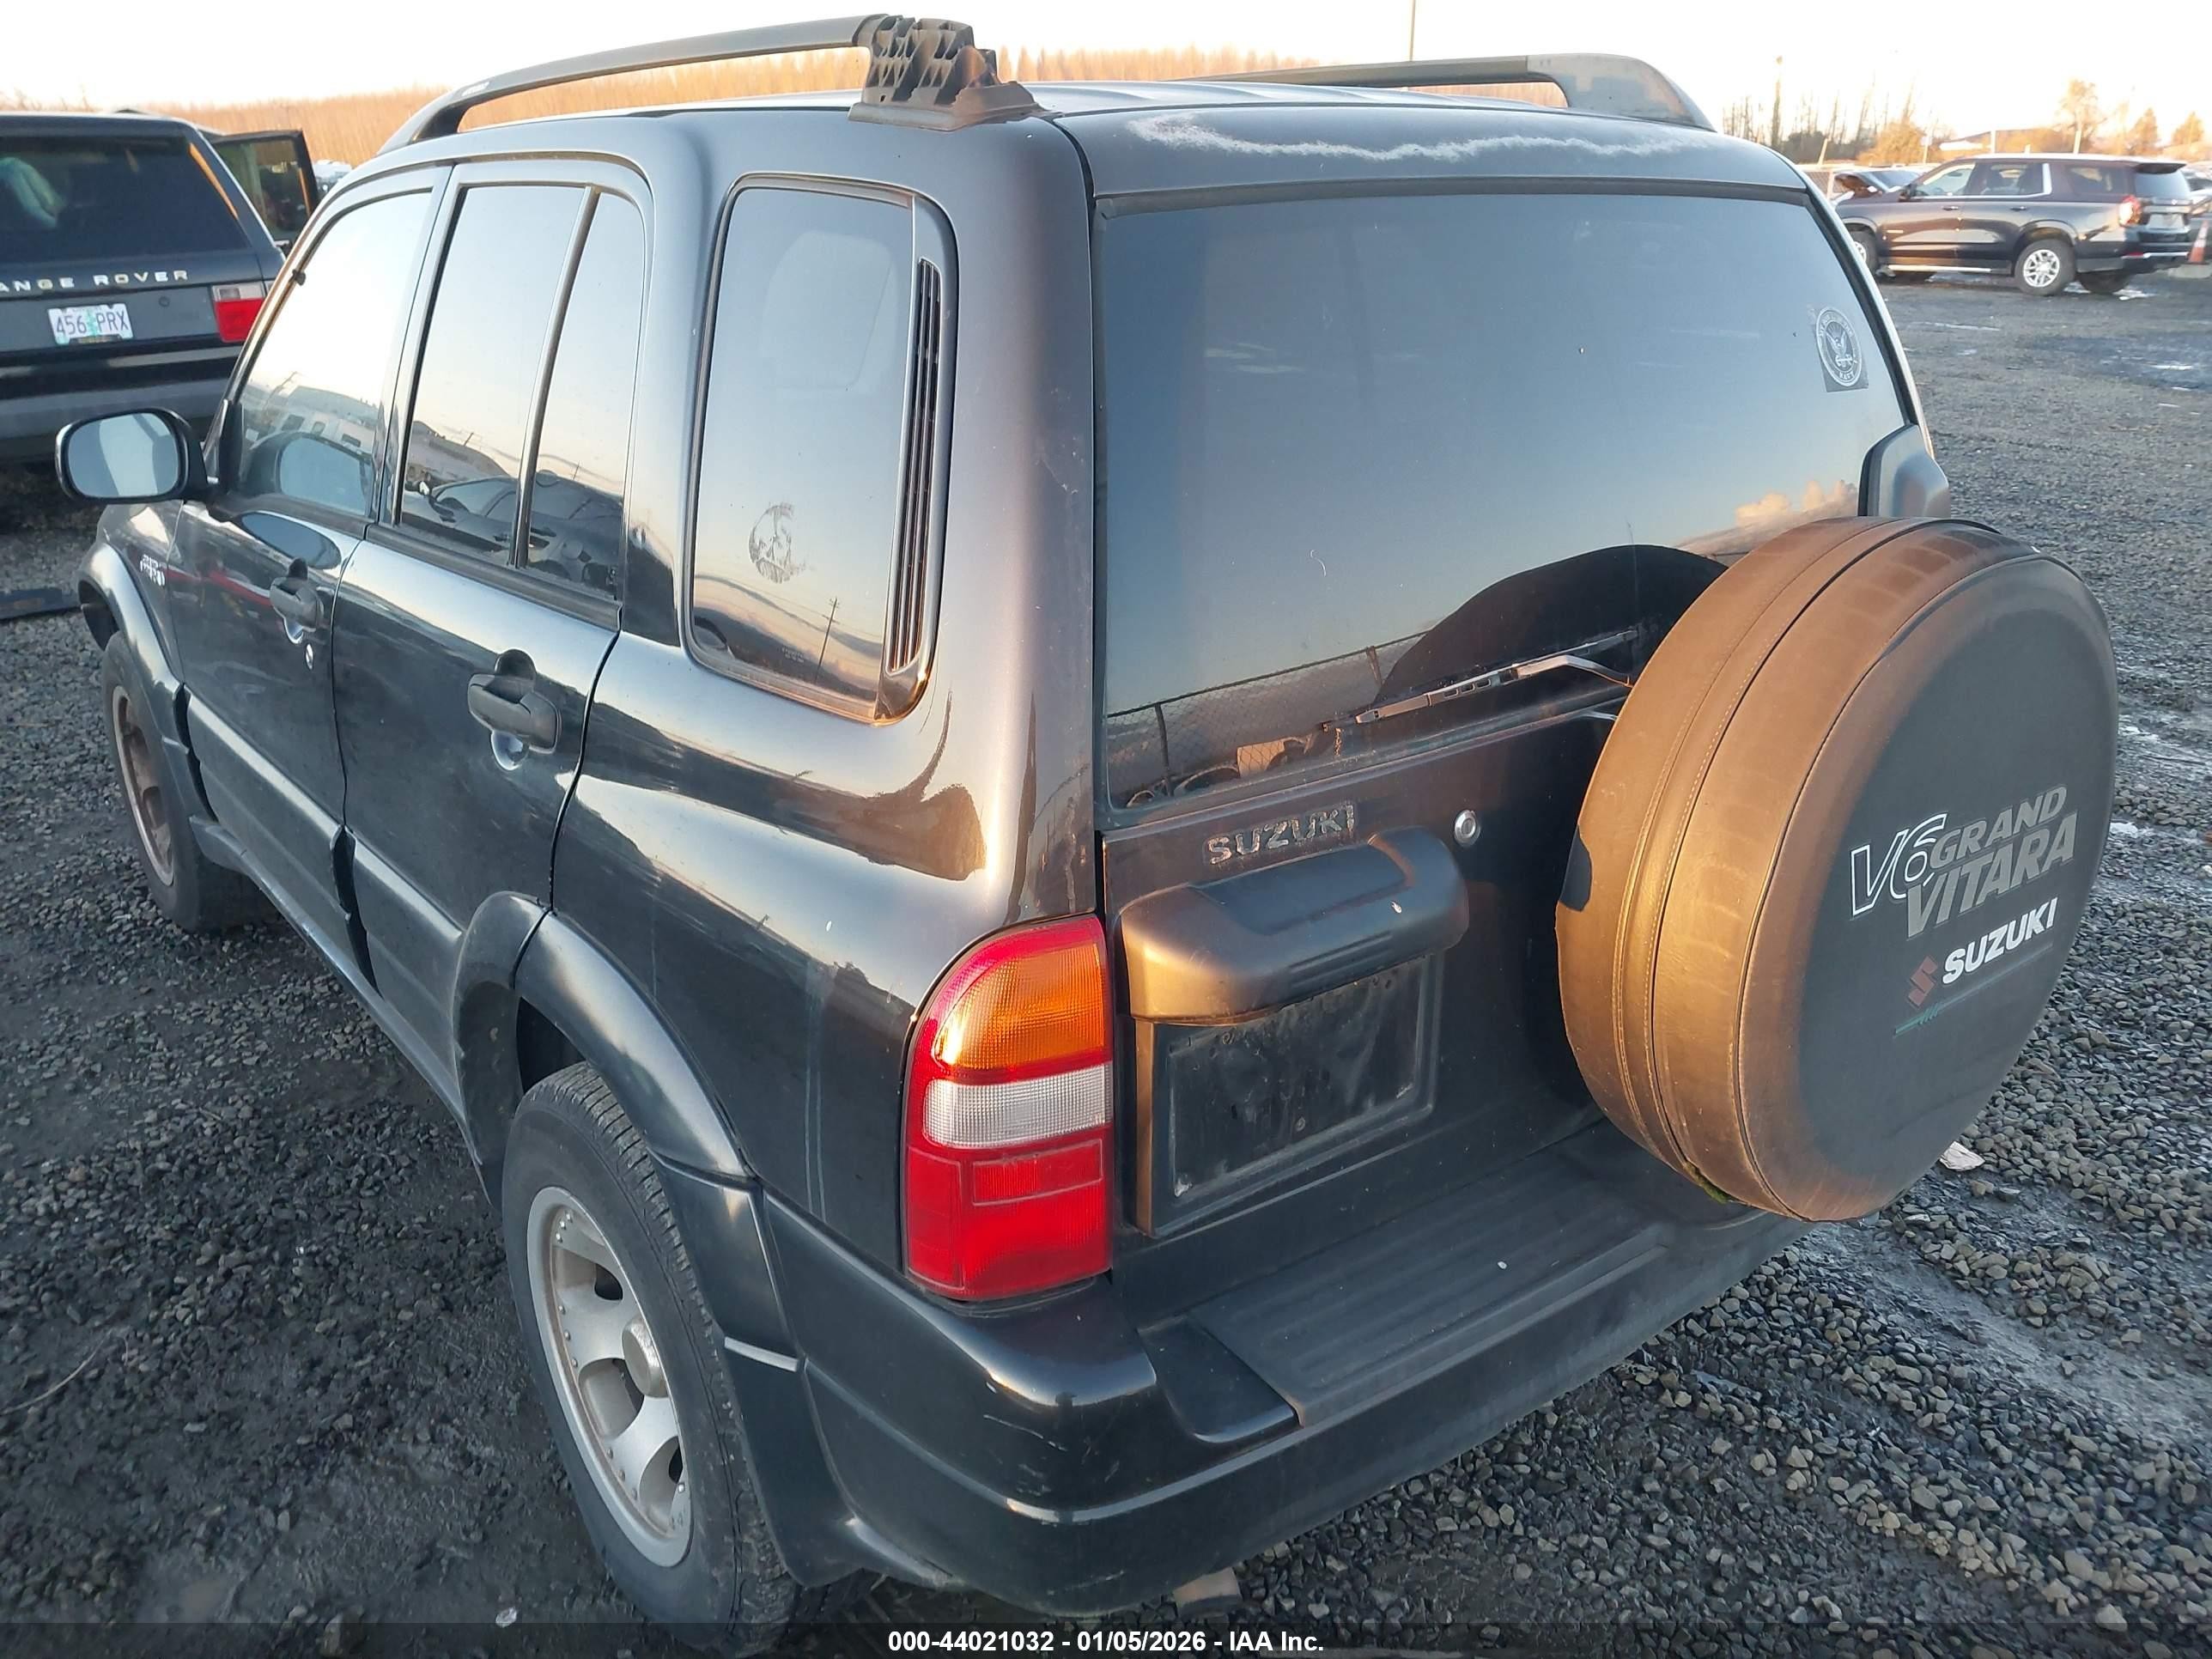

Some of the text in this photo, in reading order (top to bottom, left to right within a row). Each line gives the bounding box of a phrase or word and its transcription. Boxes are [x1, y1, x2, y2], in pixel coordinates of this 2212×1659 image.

[94, 270, 188, 286] ROVER
[57, 310, 129, 337] 456 PRX
[1207, 804, 1354, 864] SUZUKI
[1850, 811, 1948, 916] V6
[1929, 786, 2068, 869] GRAND
[1907, 812, 2078, 938] VITARA
[1942, 897, 2058, 984] SUZUKI
